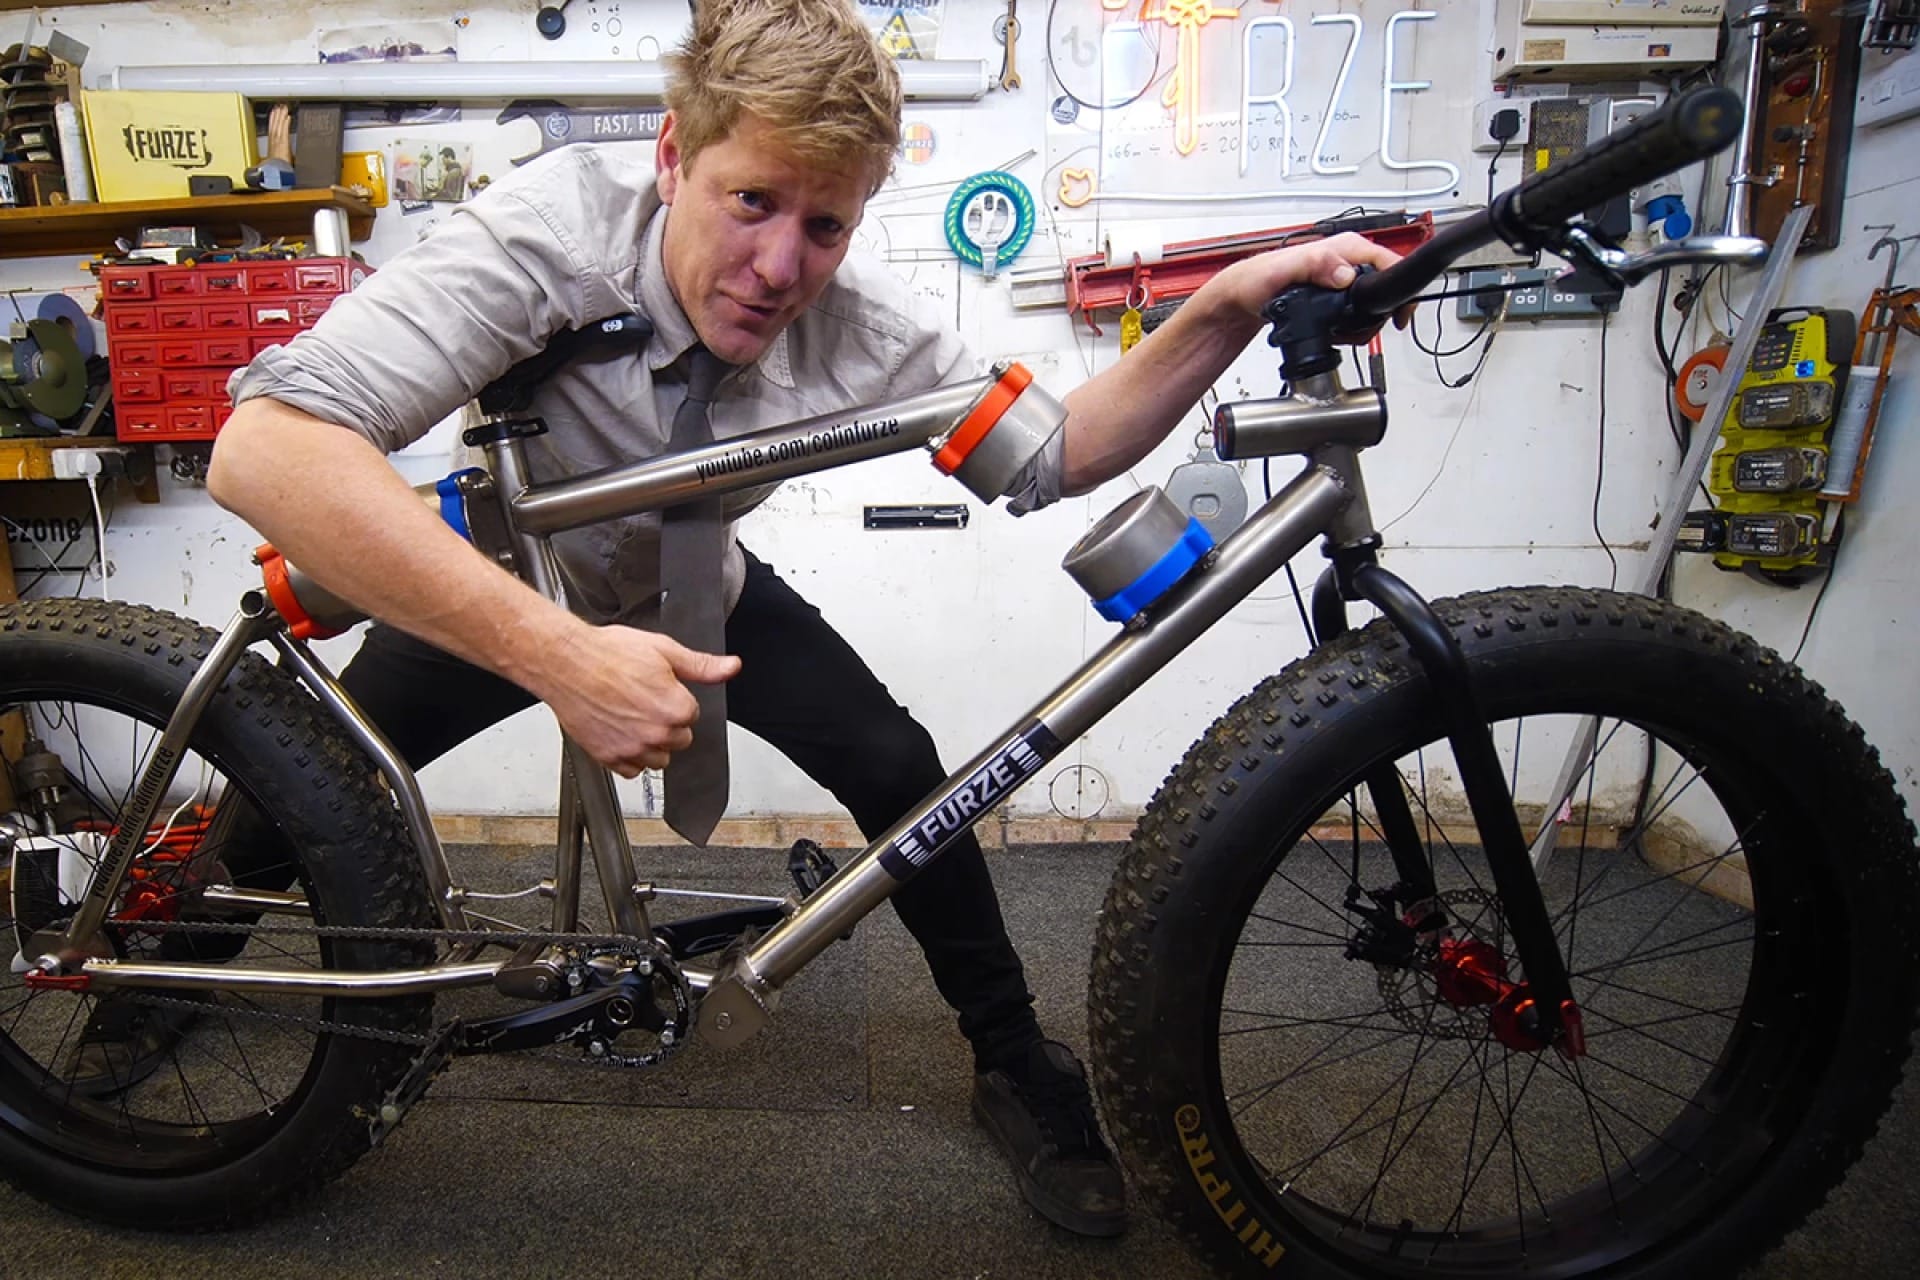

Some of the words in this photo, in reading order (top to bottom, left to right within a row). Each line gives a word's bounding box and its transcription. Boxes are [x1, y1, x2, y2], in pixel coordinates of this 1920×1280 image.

[136, 129, 199, 160] FURZE
[593, 114, 632, 135] FAST,
[696, 416, 899, 484] youtube.com/colinfurze
[920, 754, 1016, 846] FURZE
